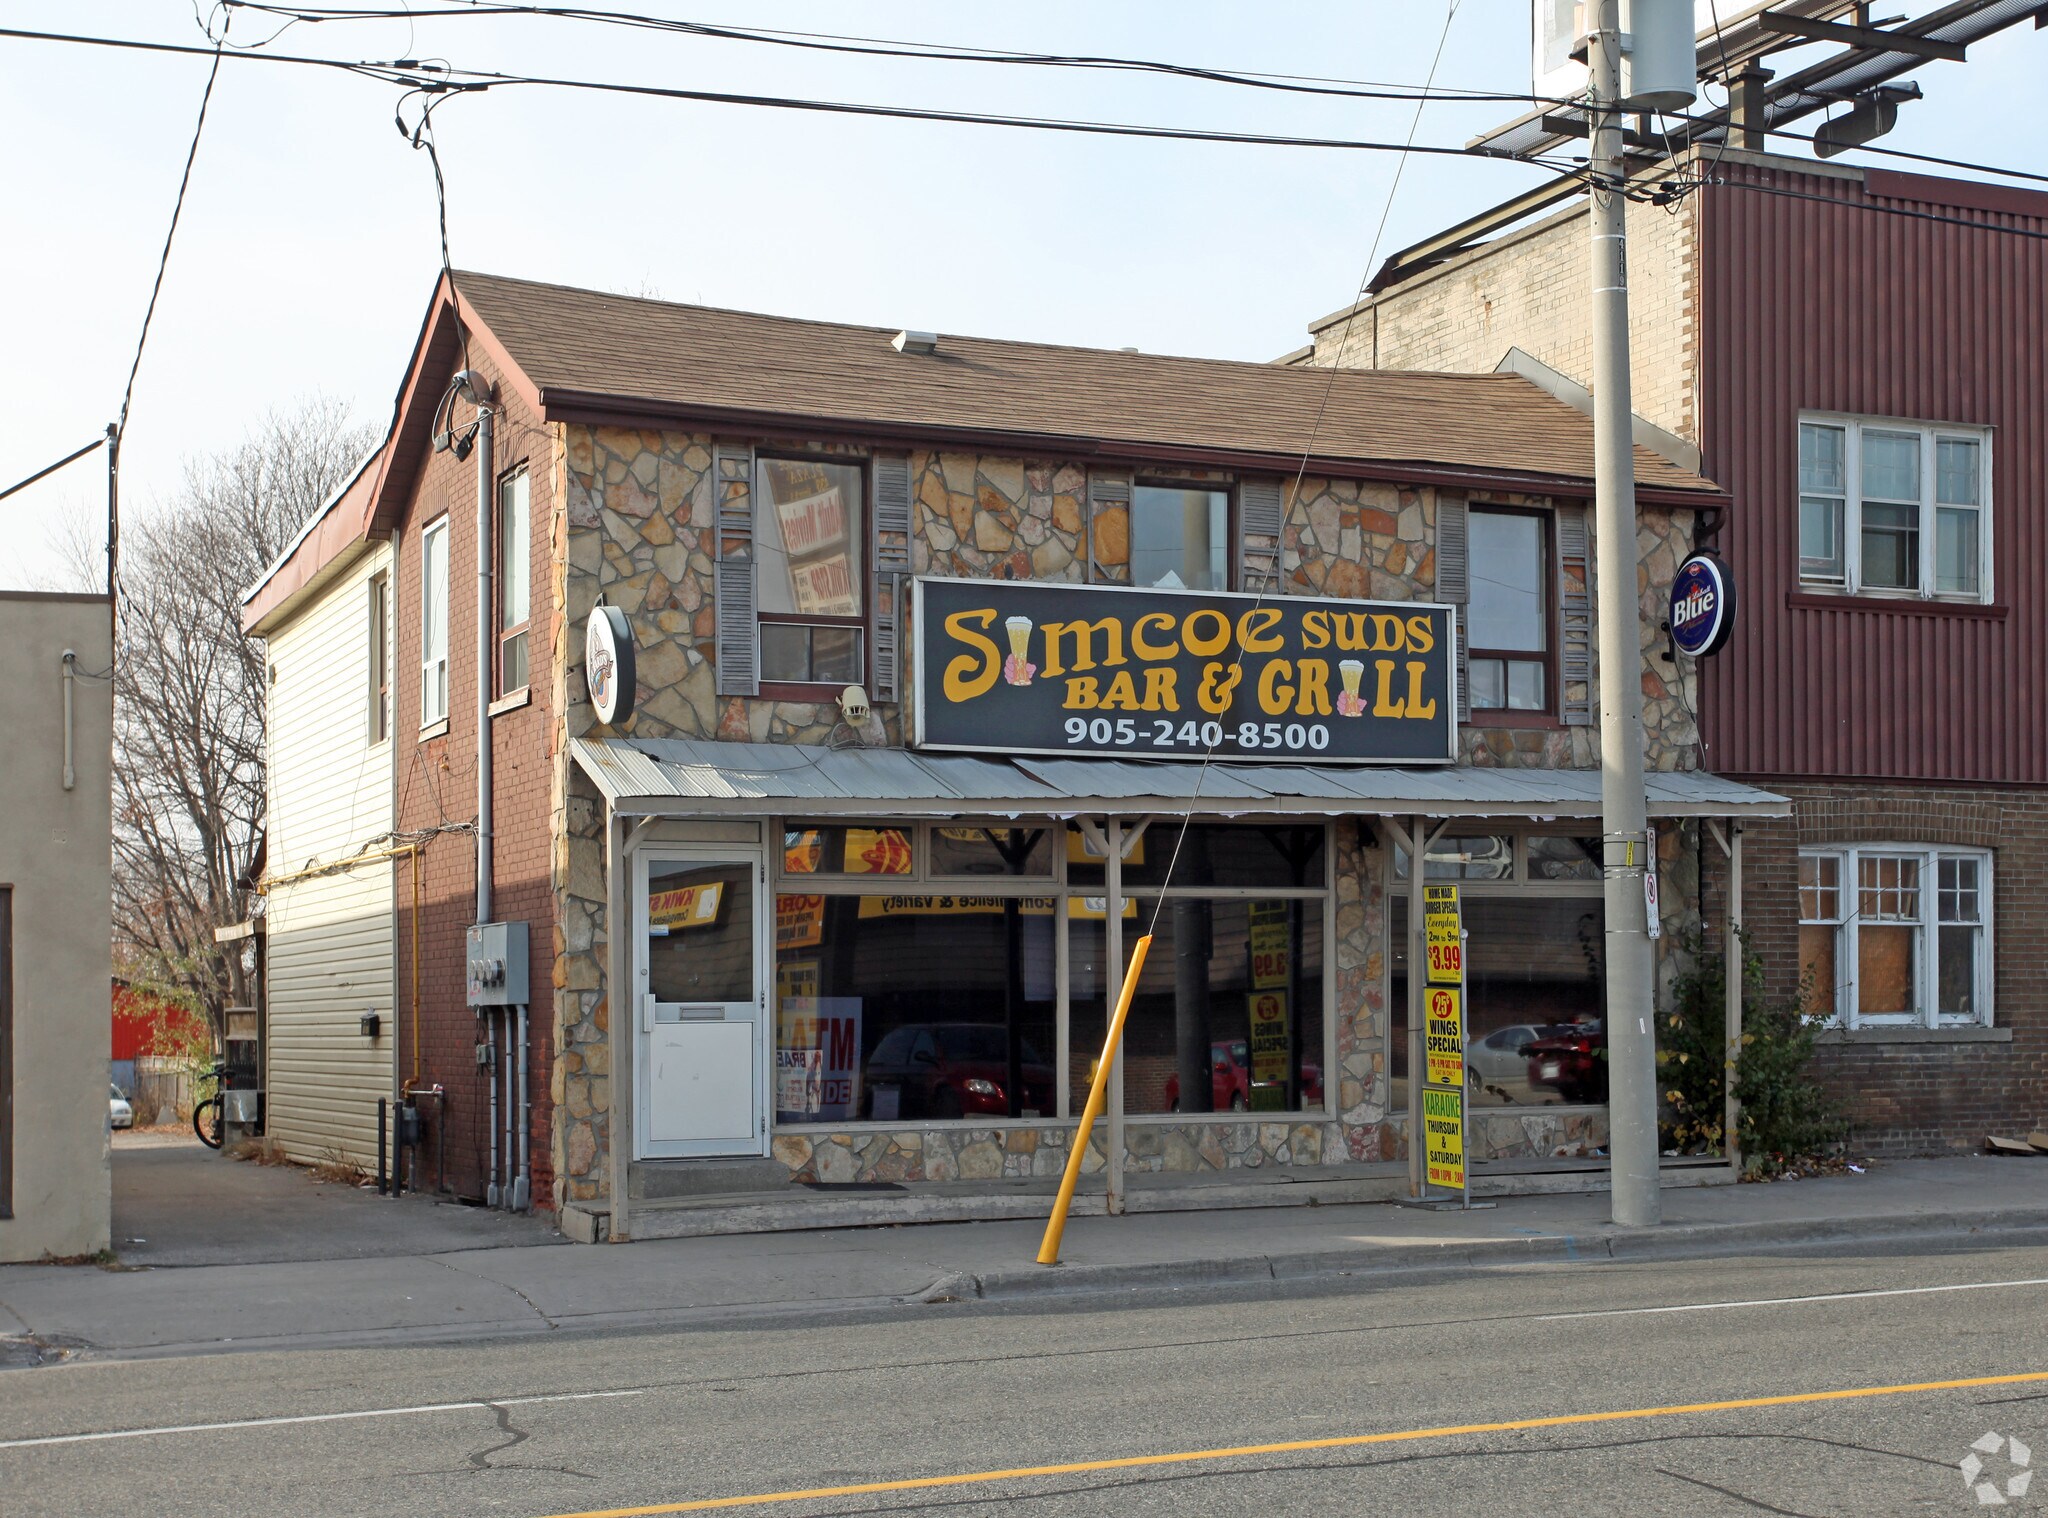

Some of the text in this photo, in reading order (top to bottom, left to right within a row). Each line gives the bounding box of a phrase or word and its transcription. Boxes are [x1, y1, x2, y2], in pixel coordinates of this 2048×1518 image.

[1673, 592, 1714, 627] Blue
[1062, 667, 1180, 711] BAR
[1197, 663, 1242, 713] &
[1064, 717, 1329, 749] 905-240-8500
[1428, 916, 1456, 929] Everyday
[1428, 945, 1461, 970] $3.99
[1429, 1019, 1458, 1036] WINGS
[1428, 1036, 1461, 1053] SPECIAL
[1425, 1092, 1460, 1118] KARAOKE
[1427, 1120, 1459, 1135] THURSDAY
[1441, 1136, 1446, 1148] &
[1430, 1150, 1461, 1165] SATURDAY
